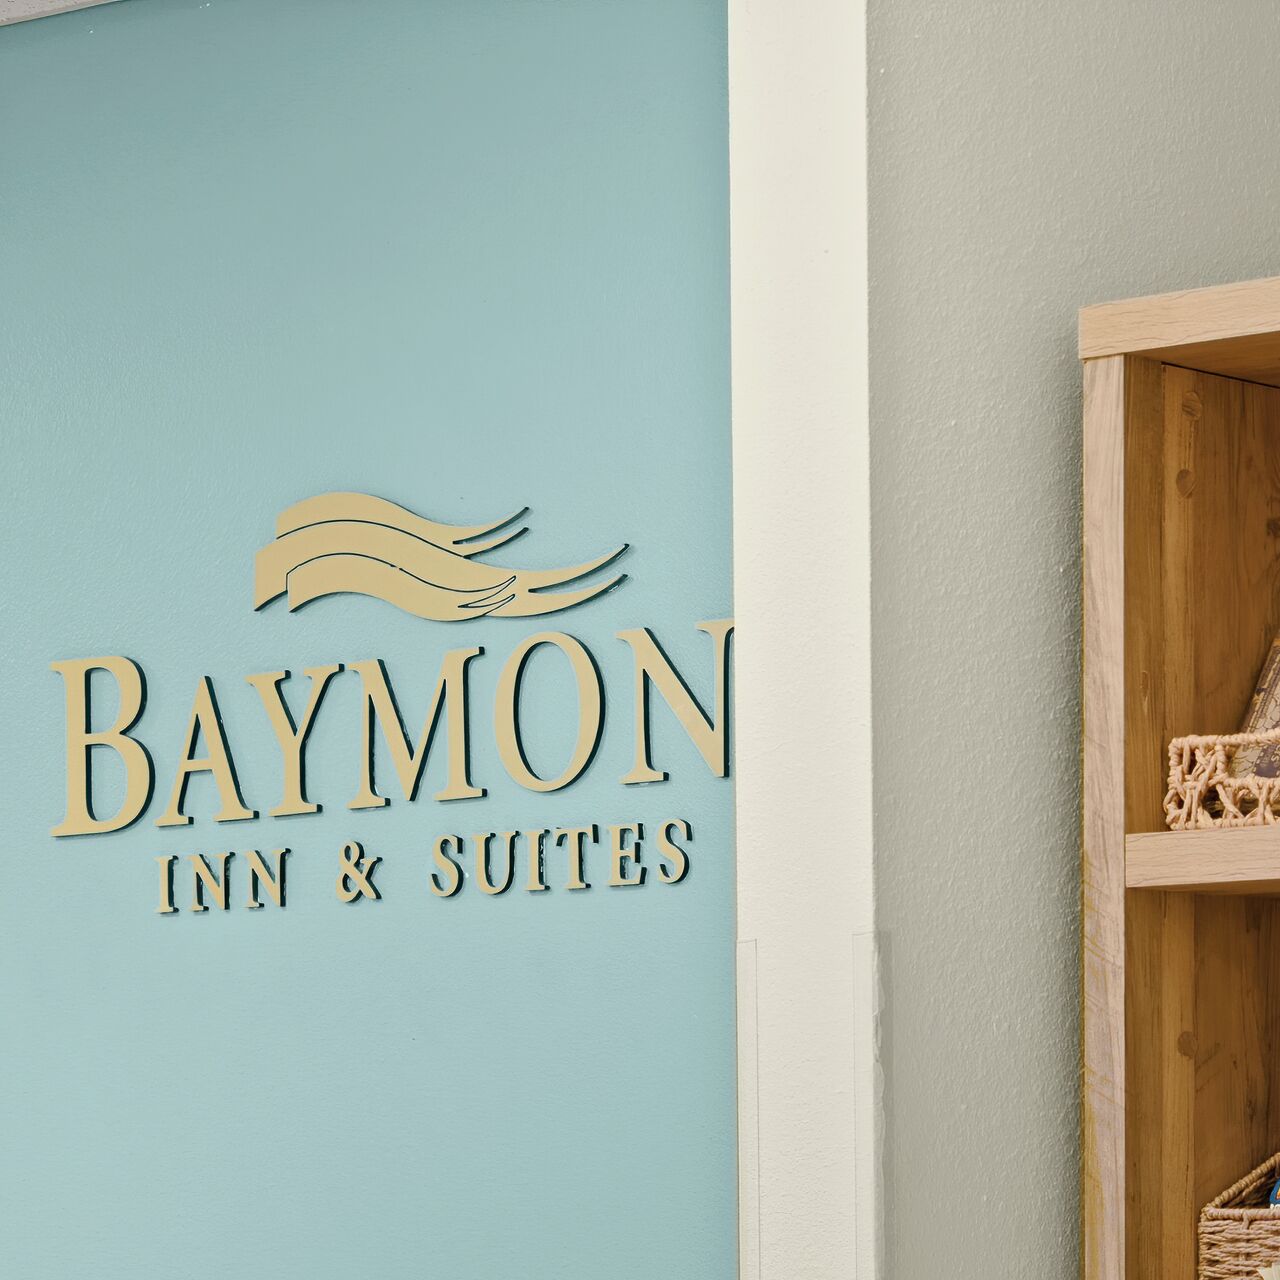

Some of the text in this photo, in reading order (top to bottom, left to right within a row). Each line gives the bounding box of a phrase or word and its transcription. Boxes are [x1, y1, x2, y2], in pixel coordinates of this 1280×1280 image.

[50, 618, 734, 838] BAYMON
[155, 818, 694, 914] INN & SUITES
